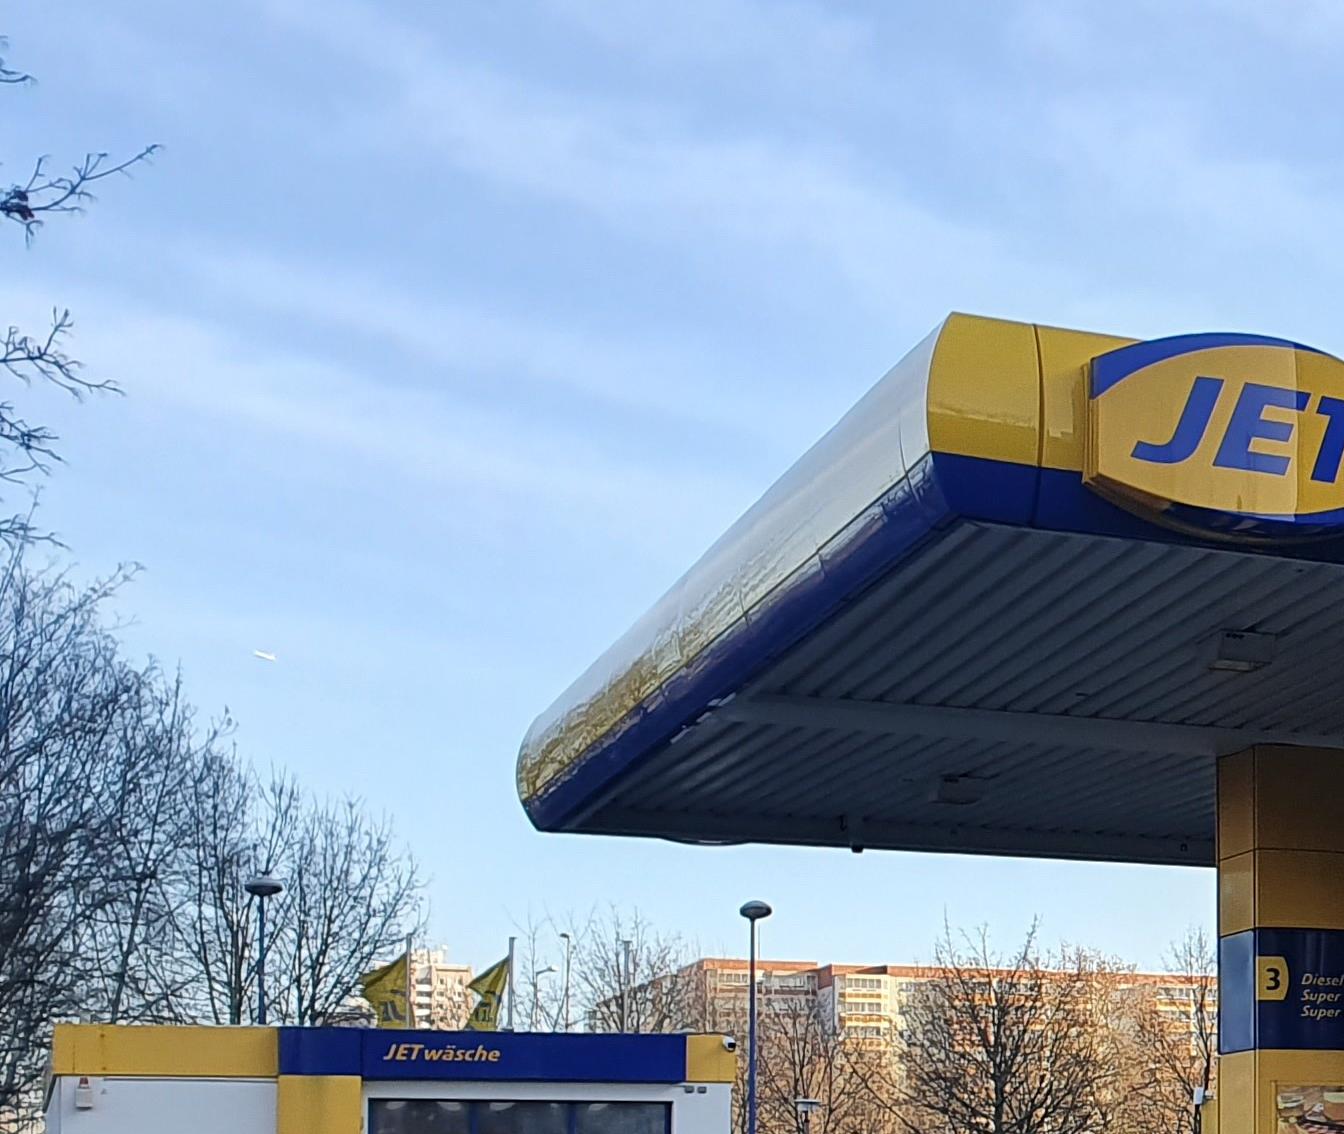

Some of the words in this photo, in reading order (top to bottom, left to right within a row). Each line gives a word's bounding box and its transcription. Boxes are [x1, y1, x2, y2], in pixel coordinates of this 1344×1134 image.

[1265, 967, 1280, 991] 3
[1301, 973, 1344, 986] Diesel
[1301, 989, 1342, 1004] Super
[1301, 1005, 1342, 1020] Super
